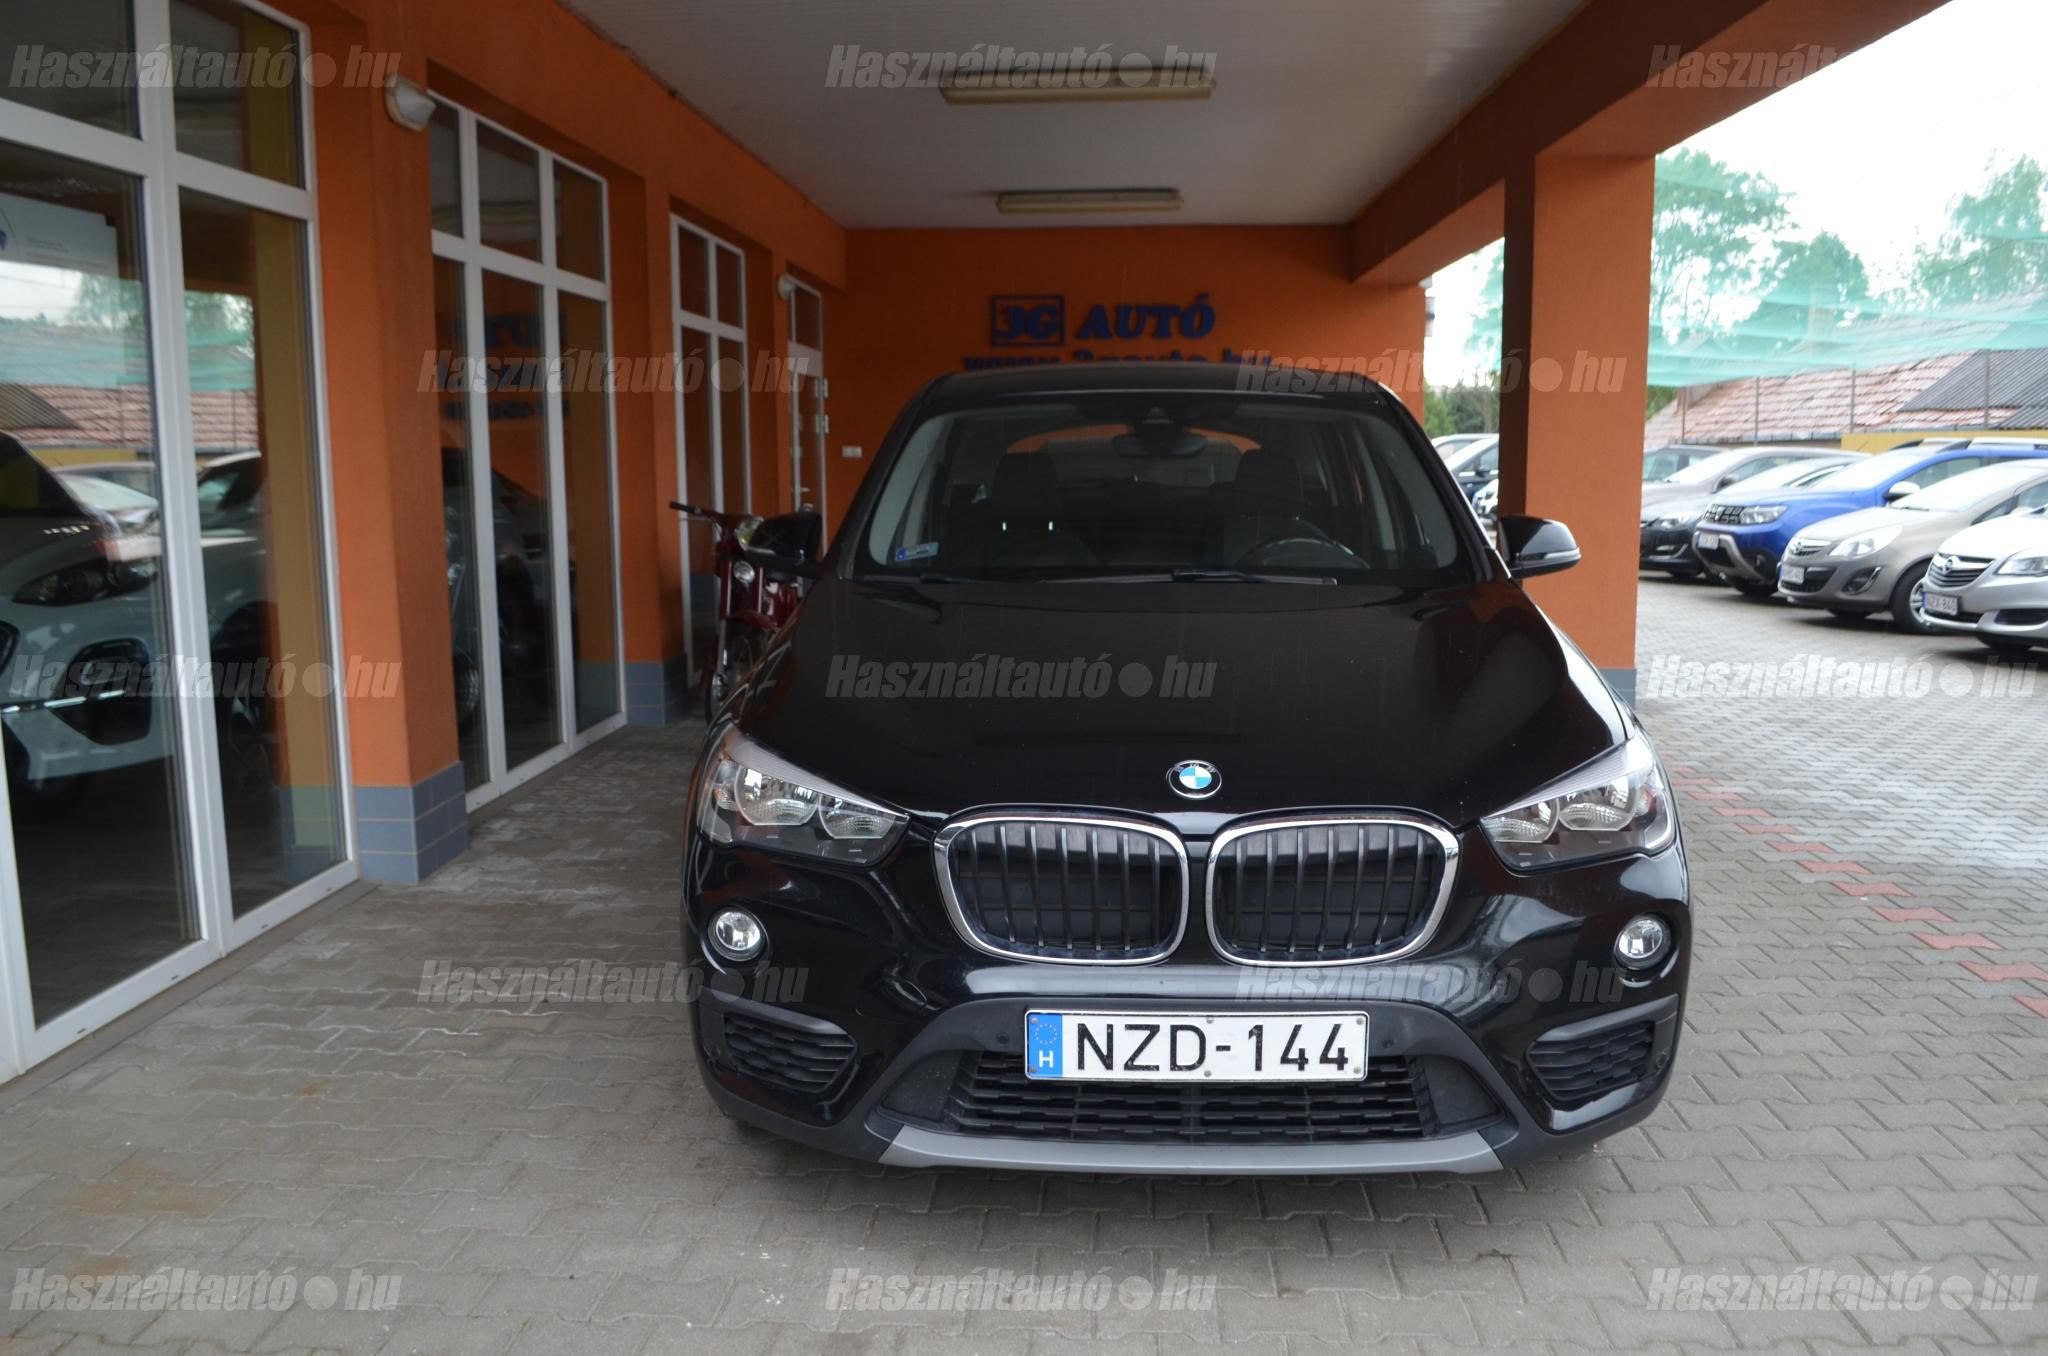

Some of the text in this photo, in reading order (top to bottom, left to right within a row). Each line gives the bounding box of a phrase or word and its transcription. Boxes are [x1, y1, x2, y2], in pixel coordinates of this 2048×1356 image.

[1000, 292, 1217, 341] 3G AUTÓ
[1038, 1051, 1054, 1068] H
[1077, 1022, 1349, 1072] NZD-144
